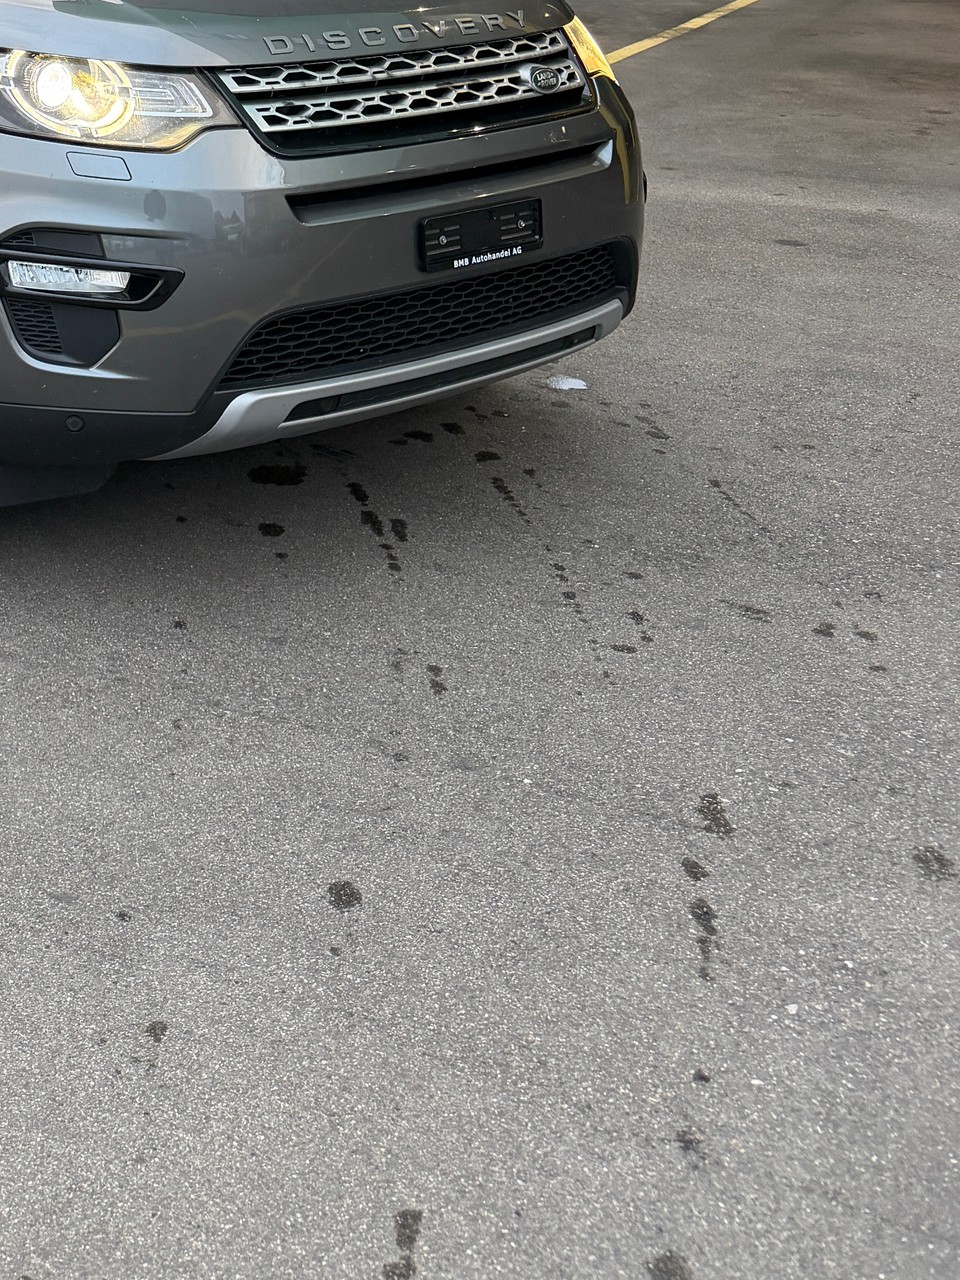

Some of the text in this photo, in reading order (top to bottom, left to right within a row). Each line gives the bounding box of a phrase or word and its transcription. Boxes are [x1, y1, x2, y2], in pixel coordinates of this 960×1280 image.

[263, 10, 525, 55] DISCOVERY
[453, 246, 522, 268] BMB Autohandel AG
